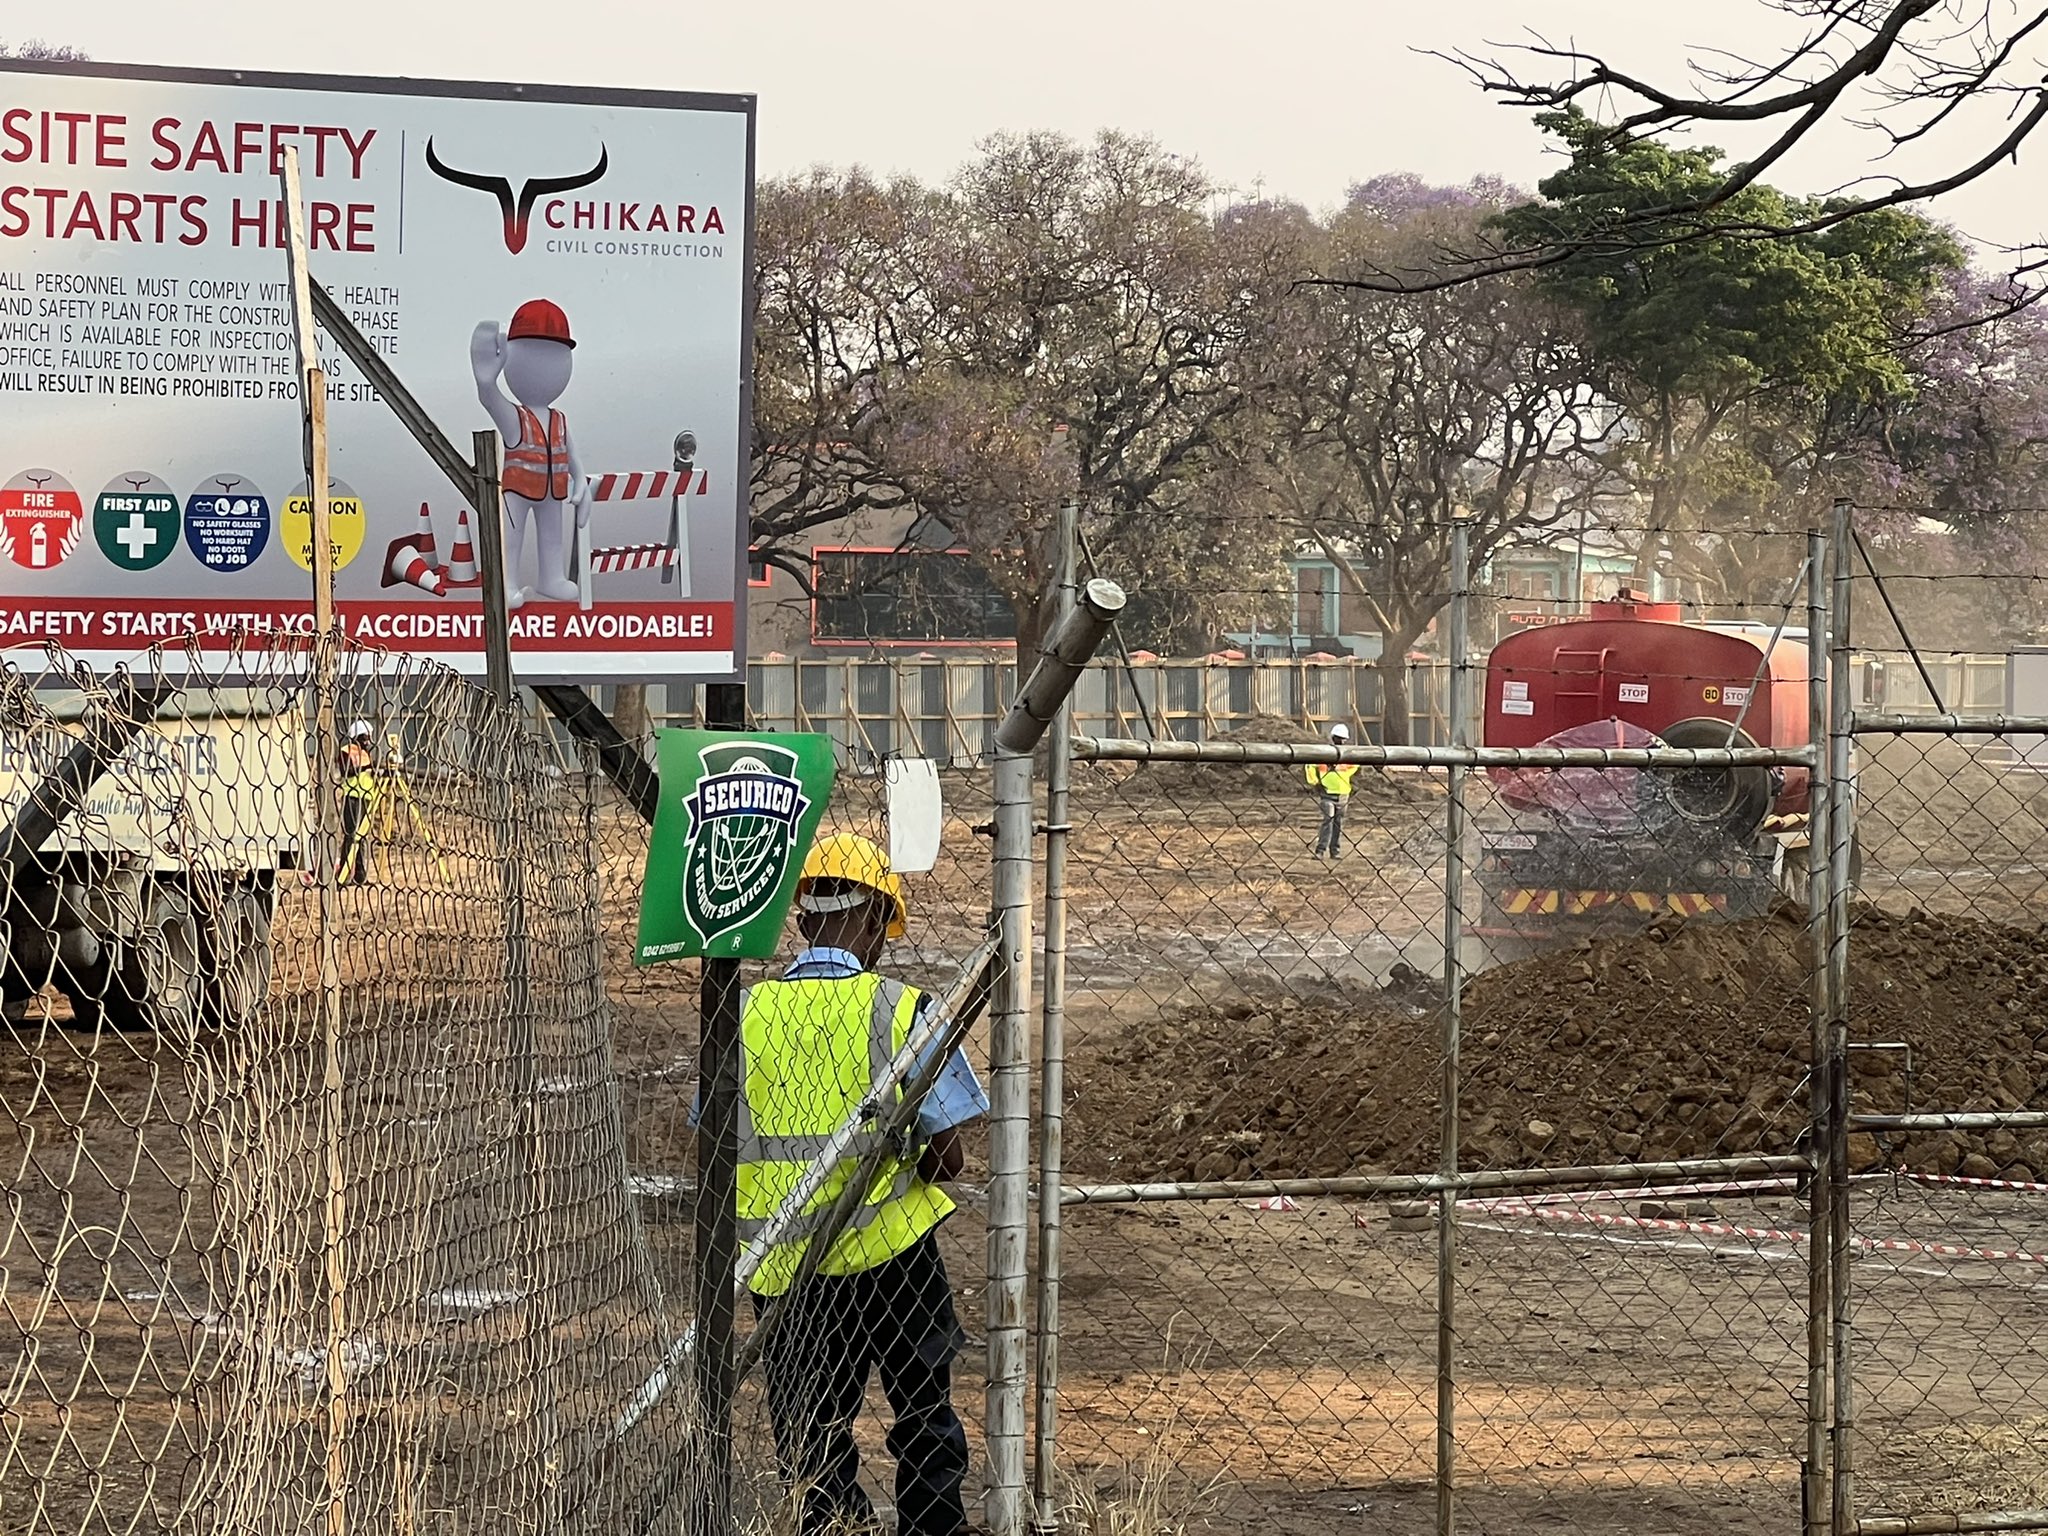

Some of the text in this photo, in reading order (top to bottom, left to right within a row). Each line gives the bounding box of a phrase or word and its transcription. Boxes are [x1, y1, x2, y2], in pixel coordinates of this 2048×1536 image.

[2, 108, 377, 179] SITE SAFETY
[0, 186, 208, 246] STARTS
[544, 199, 725, 235] CHIKARA
[546, 240, 723, 258] CIVIL CONSTRUCTION
[0, 272, 25, 291] ALL
[36, 273, 127, 295] PERSONNEL
[137, 278, 178, 297] MUST
[189, 280, 250, 300] COMPLY
[345, 286, 399, 306] HEALTH
[0, 297, 399, 330] AND SAFETY PLAN FOR THE CONSTRU PHASE
[0, 322, 50, 342] WHICH
[60, 324, 72, 343] IS
[81, 325, 161, 346] AVAILABLE
[171, 328, 201, 348] FOR
[210, 330, 297, 351] INSPECTION
[369, 336, 398, 354] SITE
[0, 346, 56, 370] OFFICE,
[62, 350, 122, 369] FAILURE
[127, 351, 148, 371] TO
[153, 352, 214, 373] COMPLY
[219, 355, 257, 374] WITH
[262, 356, 290, 375] THE
[0, 372, 32, 391] WILL
[38, 373, 94, 393] RESULT
[99, 375, 114, 394] IN
[121, 376, 167, 396] BEING
[173, 378, 263, 398] PROHIBITED
[269, 381, 299, 400] FRO
[324, 382, 346, 401] HE
[23, 493, 54, 508] FIRE
[102, 497, 172, 512] FIRST AID
[289, 500, 357, 515] CAION
[5, 509, 71, 519] EXTINGUISHER
[192, 520, 261, 529] NO SAFETY GLASSES
[207, 545, 220, 553] NO
[215, 537, 236, 545] HARD
[206, 553, 247, 564] NO JOB
[0, 609, 713, 639] SAFETY STARTS WITH YO! ACCIDENT ARE AVOIDABLE!
[1510, 615, 1545, 624] AUTO
[1621, 689, 1647, 697] STOP
[1704, 689, 1718, 699] 80
[704, 780, 794, 814] SECURICO
[695, 862, 775, 919] SECURITY SERVICES
